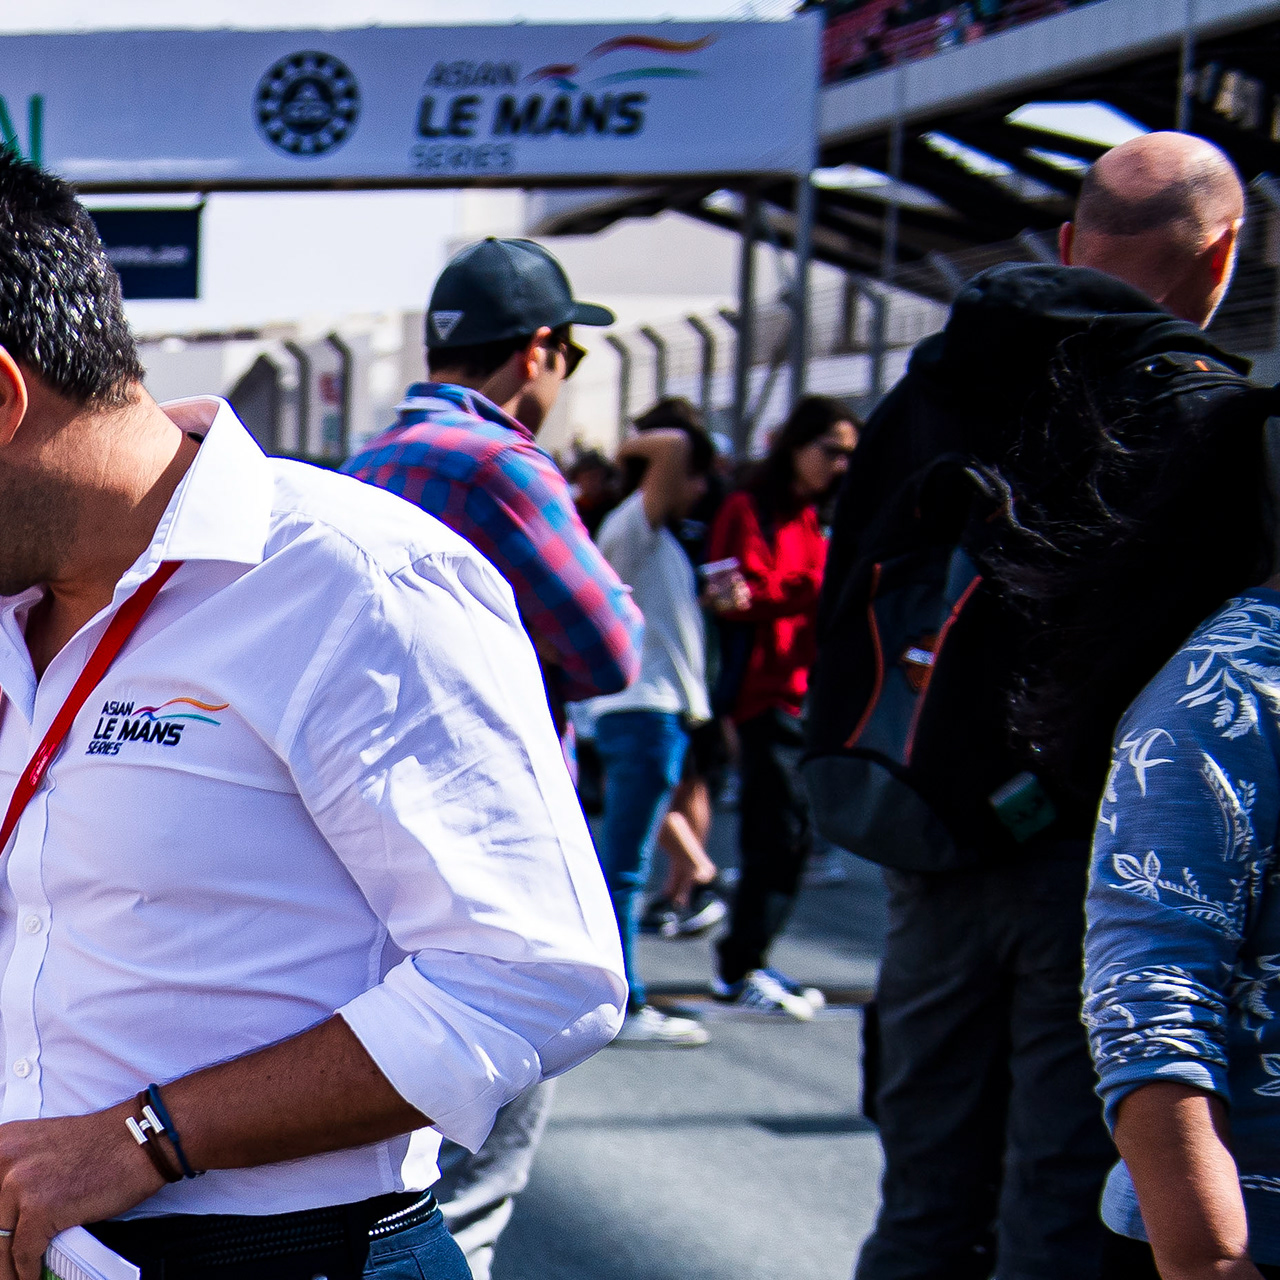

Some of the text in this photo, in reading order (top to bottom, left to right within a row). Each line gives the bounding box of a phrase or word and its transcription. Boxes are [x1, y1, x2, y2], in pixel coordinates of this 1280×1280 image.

[417, 91, 650, 138] LE MANS
[101, 700, 134, 716] ASIAN
[93, 717, 185, 746] LE MANS
[85, 741, 124, 756] SERIES
